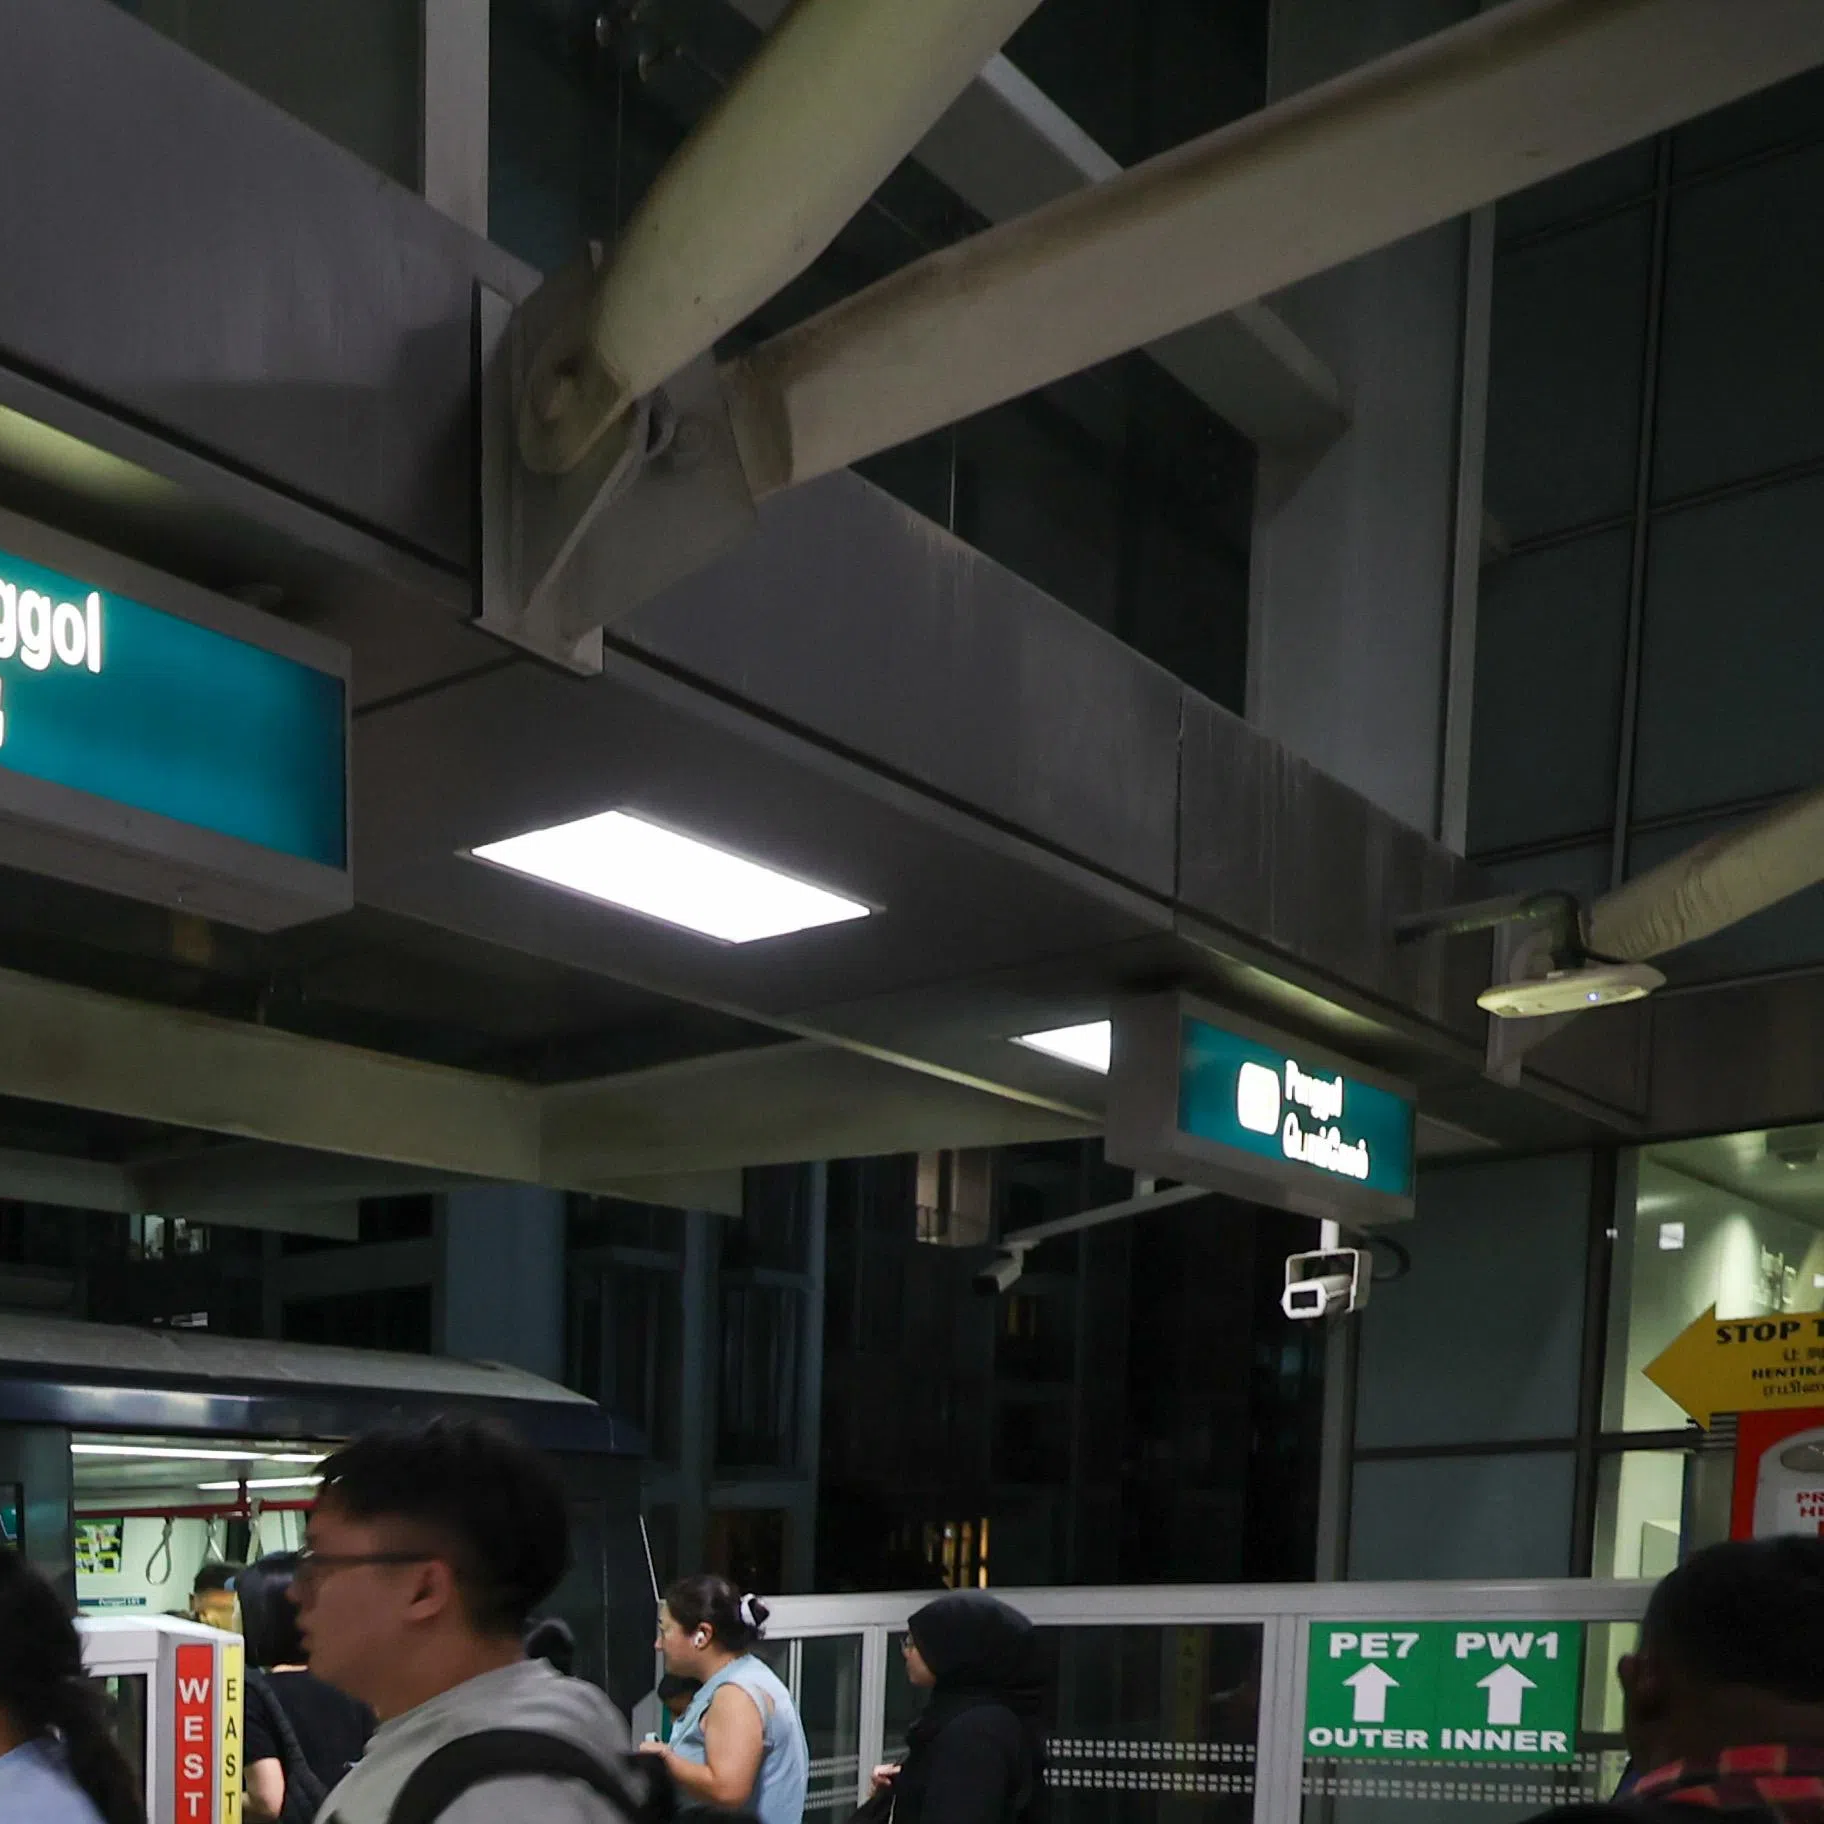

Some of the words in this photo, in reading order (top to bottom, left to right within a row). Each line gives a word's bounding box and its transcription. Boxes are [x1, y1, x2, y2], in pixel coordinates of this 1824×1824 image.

[1716, 1320, 1800, 1344] STOP
[1330, 1632, 1420, 1659] PE7
[1455, 1632, 1559, 1659] PW1
[178, 1677, 210, 1818] WEST
[224, 1677, 238, 1816] EAST
[1308, 1727, 1429, 1750] OUTER
[1440, 1728, 1568, 1752] INNER
